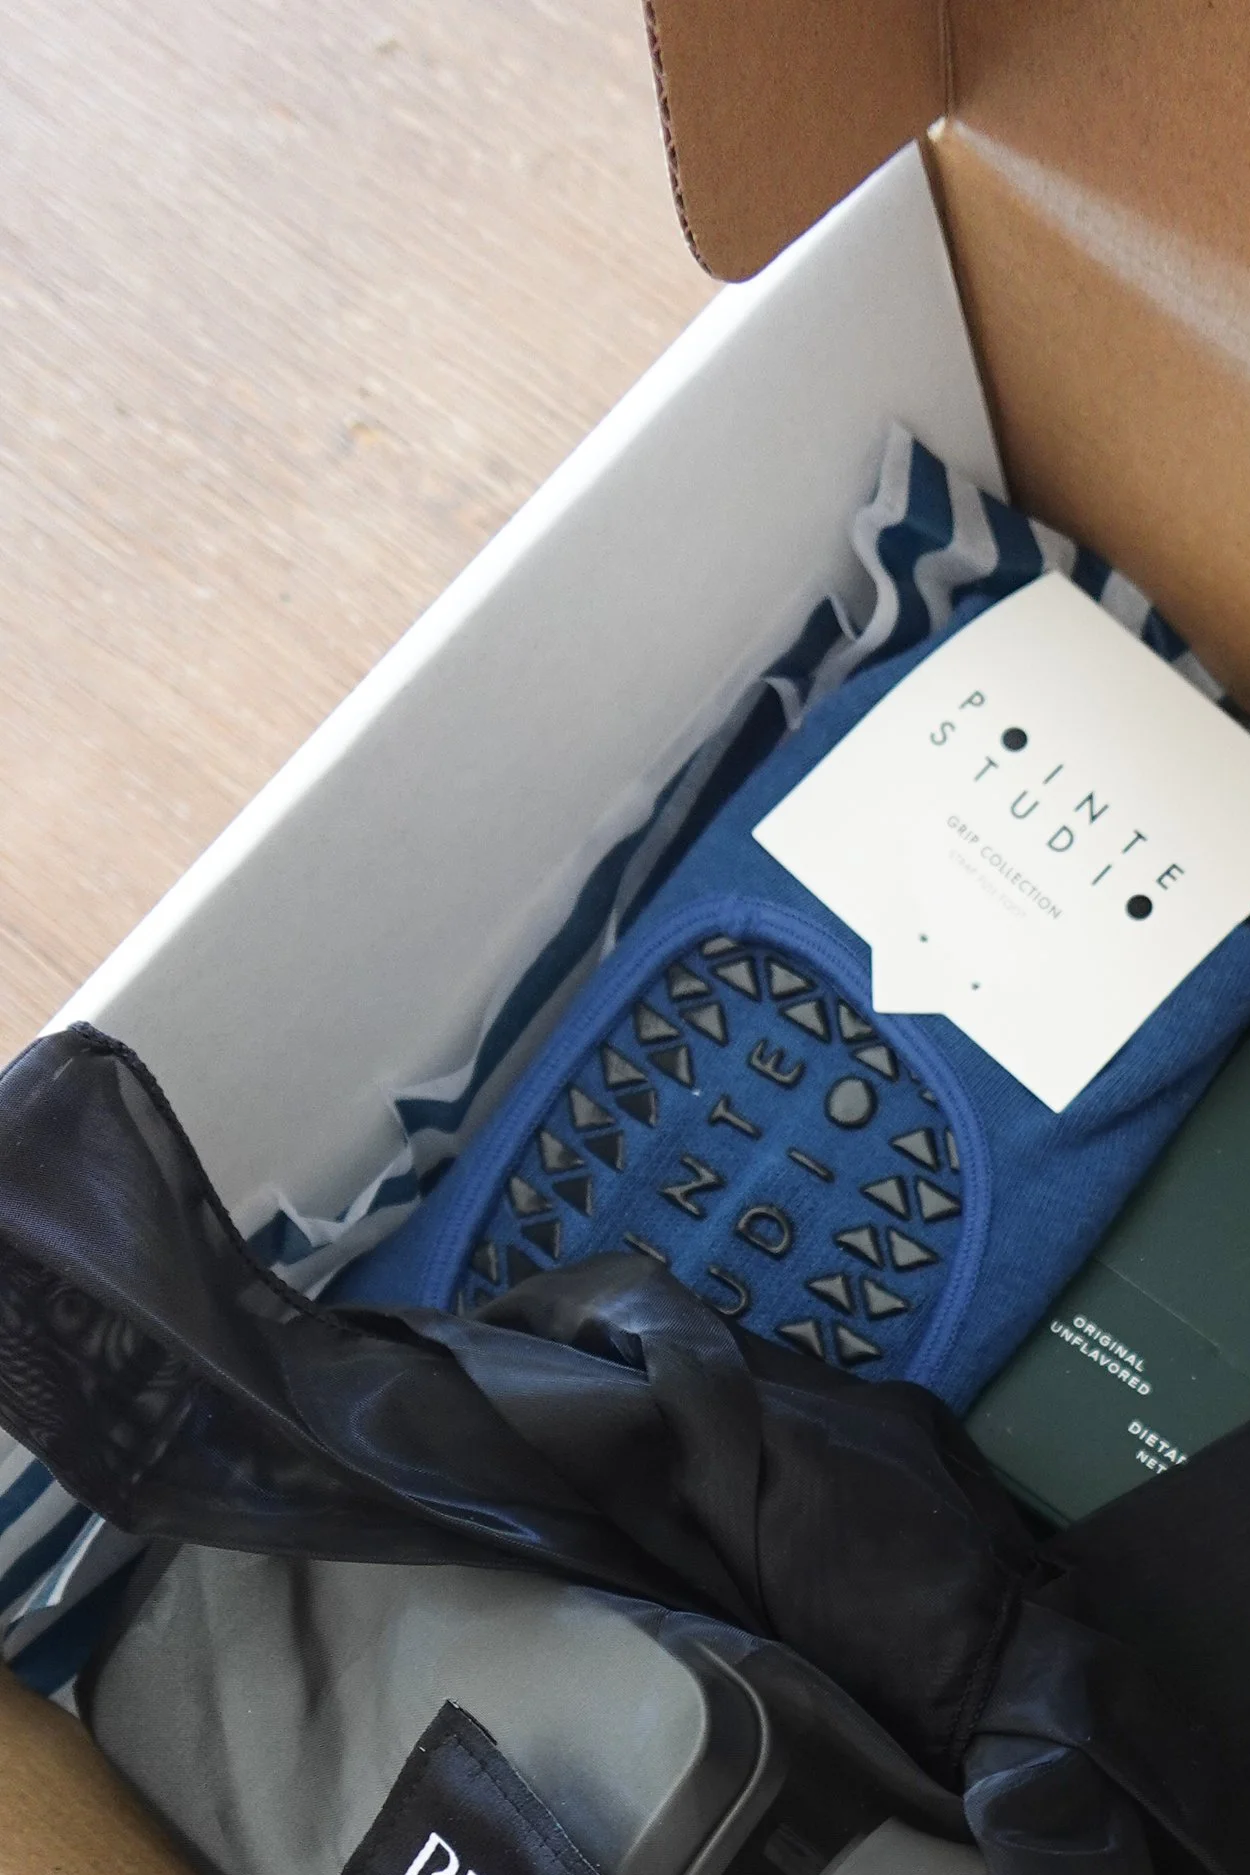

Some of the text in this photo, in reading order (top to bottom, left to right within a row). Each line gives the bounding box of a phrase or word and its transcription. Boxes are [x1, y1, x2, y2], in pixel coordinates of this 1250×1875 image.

[946, 815, 1063, 920] GRIP COLLECTION
[623, 1036, 805, 1266] INTE
[708, 1076, 878, 1318] UDIO
[1050, 1320, 1151, 1396] UNFLAVORED
[1073, 1314, 1145, 1372] ORIGINAL
[1135, 1450, 1168, 1475] NET
